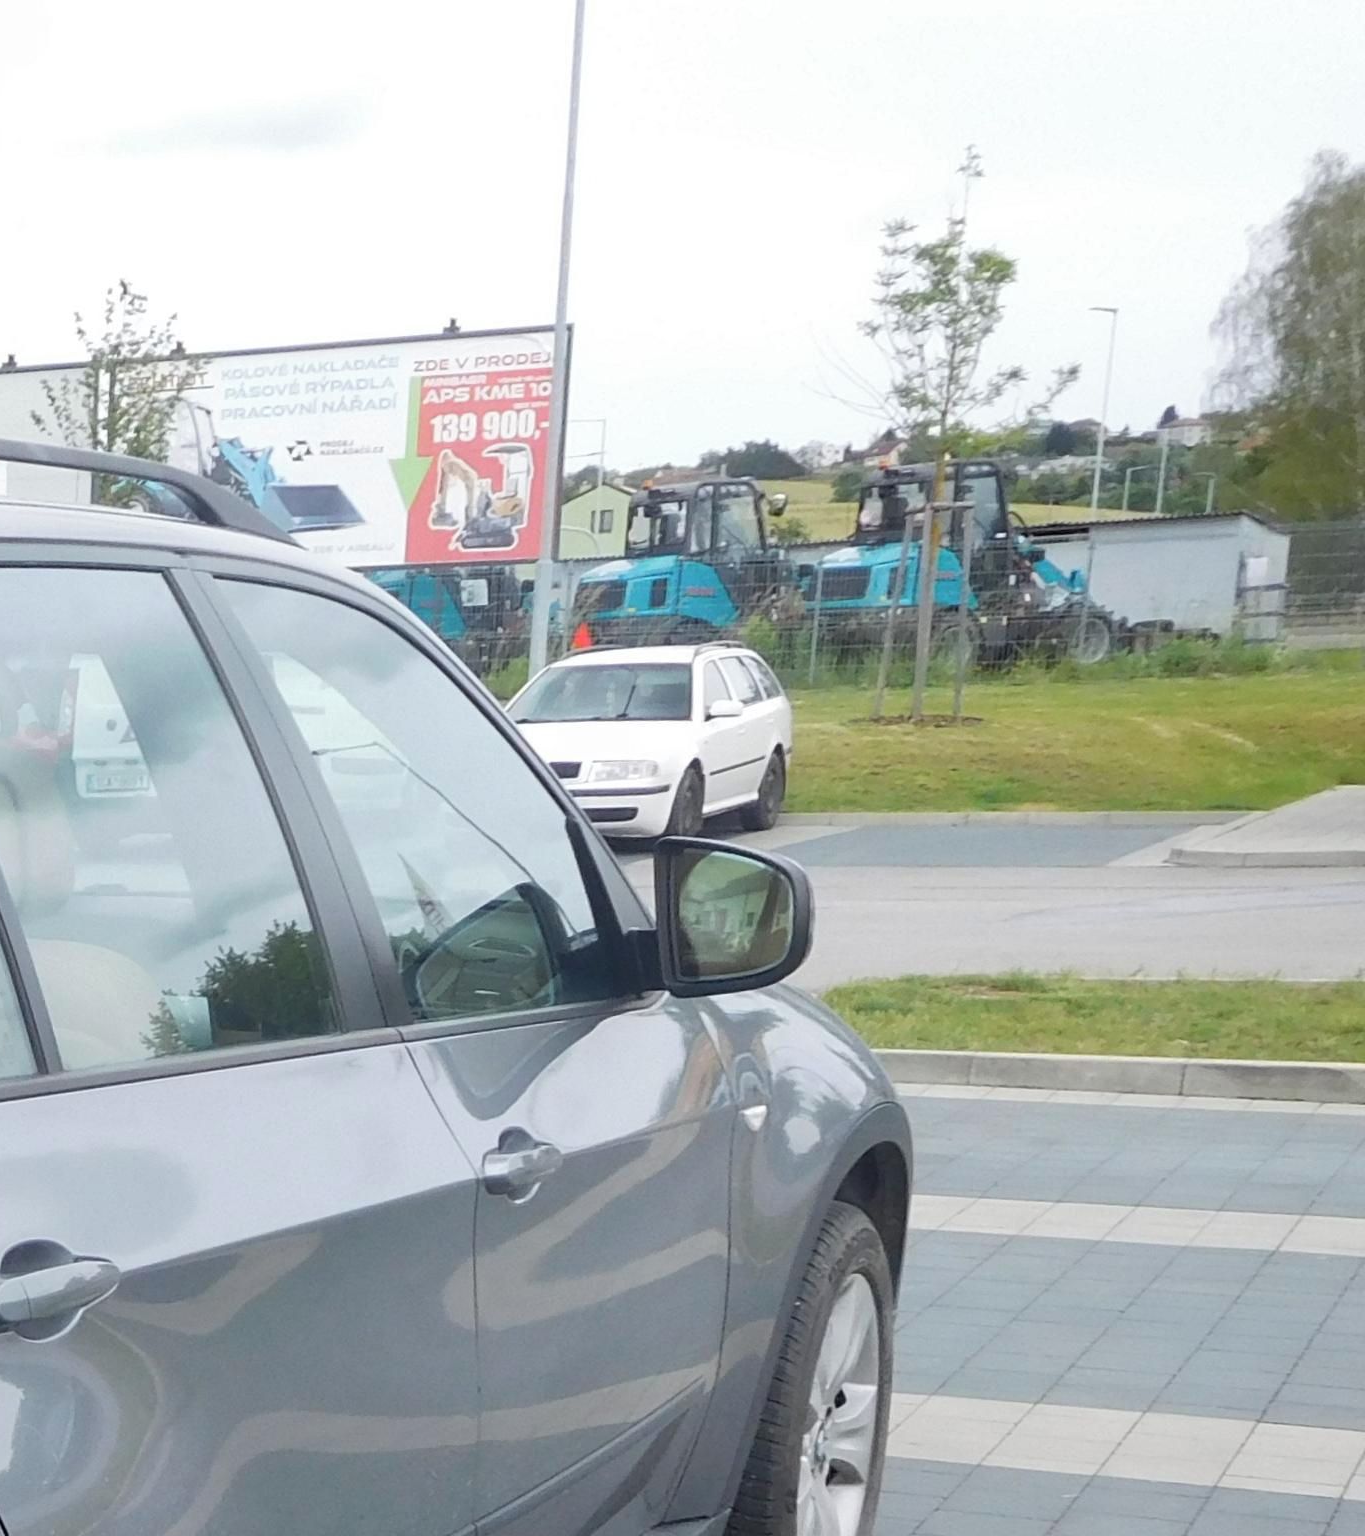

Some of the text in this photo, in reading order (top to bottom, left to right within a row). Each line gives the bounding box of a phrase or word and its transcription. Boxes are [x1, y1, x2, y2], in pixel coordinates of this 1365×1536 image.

[221, 364, 288, 380] KOLOVÉ
[293, 355, 400, 375] NAKLADAČE
[413, 358, 450, 372] ZDE
[455, 357, 469, 369] V
[224, 379, 300, 399] PÁSOVÉ
[305, 376, 396, 395] RÝPADLA
[423, 381, 553, 405] APS KME 10
[221, 393, 397, 420] PRACOVNÍ NÁŘADÍ
[430, 412, 477, 444] 139
